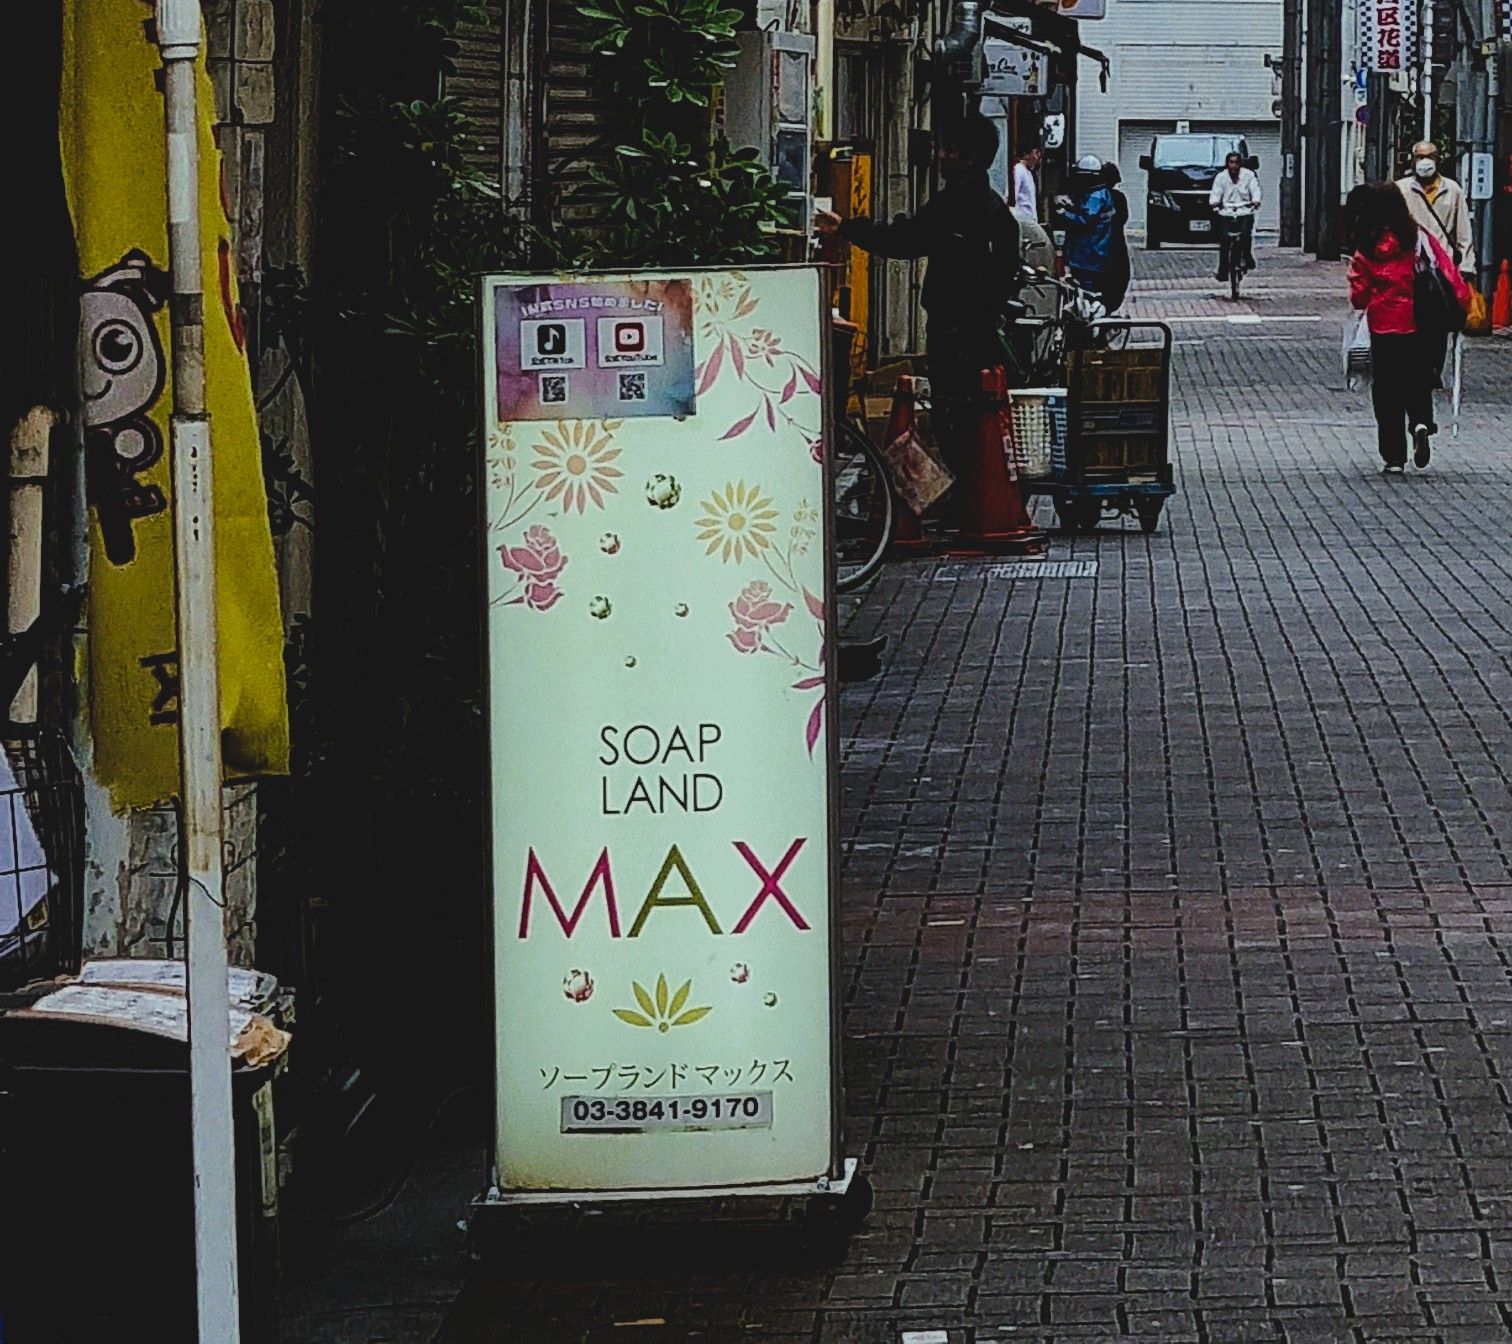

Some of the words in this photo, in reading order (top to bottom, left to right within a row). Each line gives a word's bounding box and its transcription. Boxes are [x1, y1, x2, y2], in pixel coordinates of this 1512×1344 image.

[599, 723, 722, 766] SOAP
[602, 773, 723, 815] LAND
[517, 837, 812, 939] MAX
[540, 1062, 688, 1090] ソープランド
[694, 1059, 794, 1087] マックス
[573, 1096, 760, 1121] 03-3841-9170
